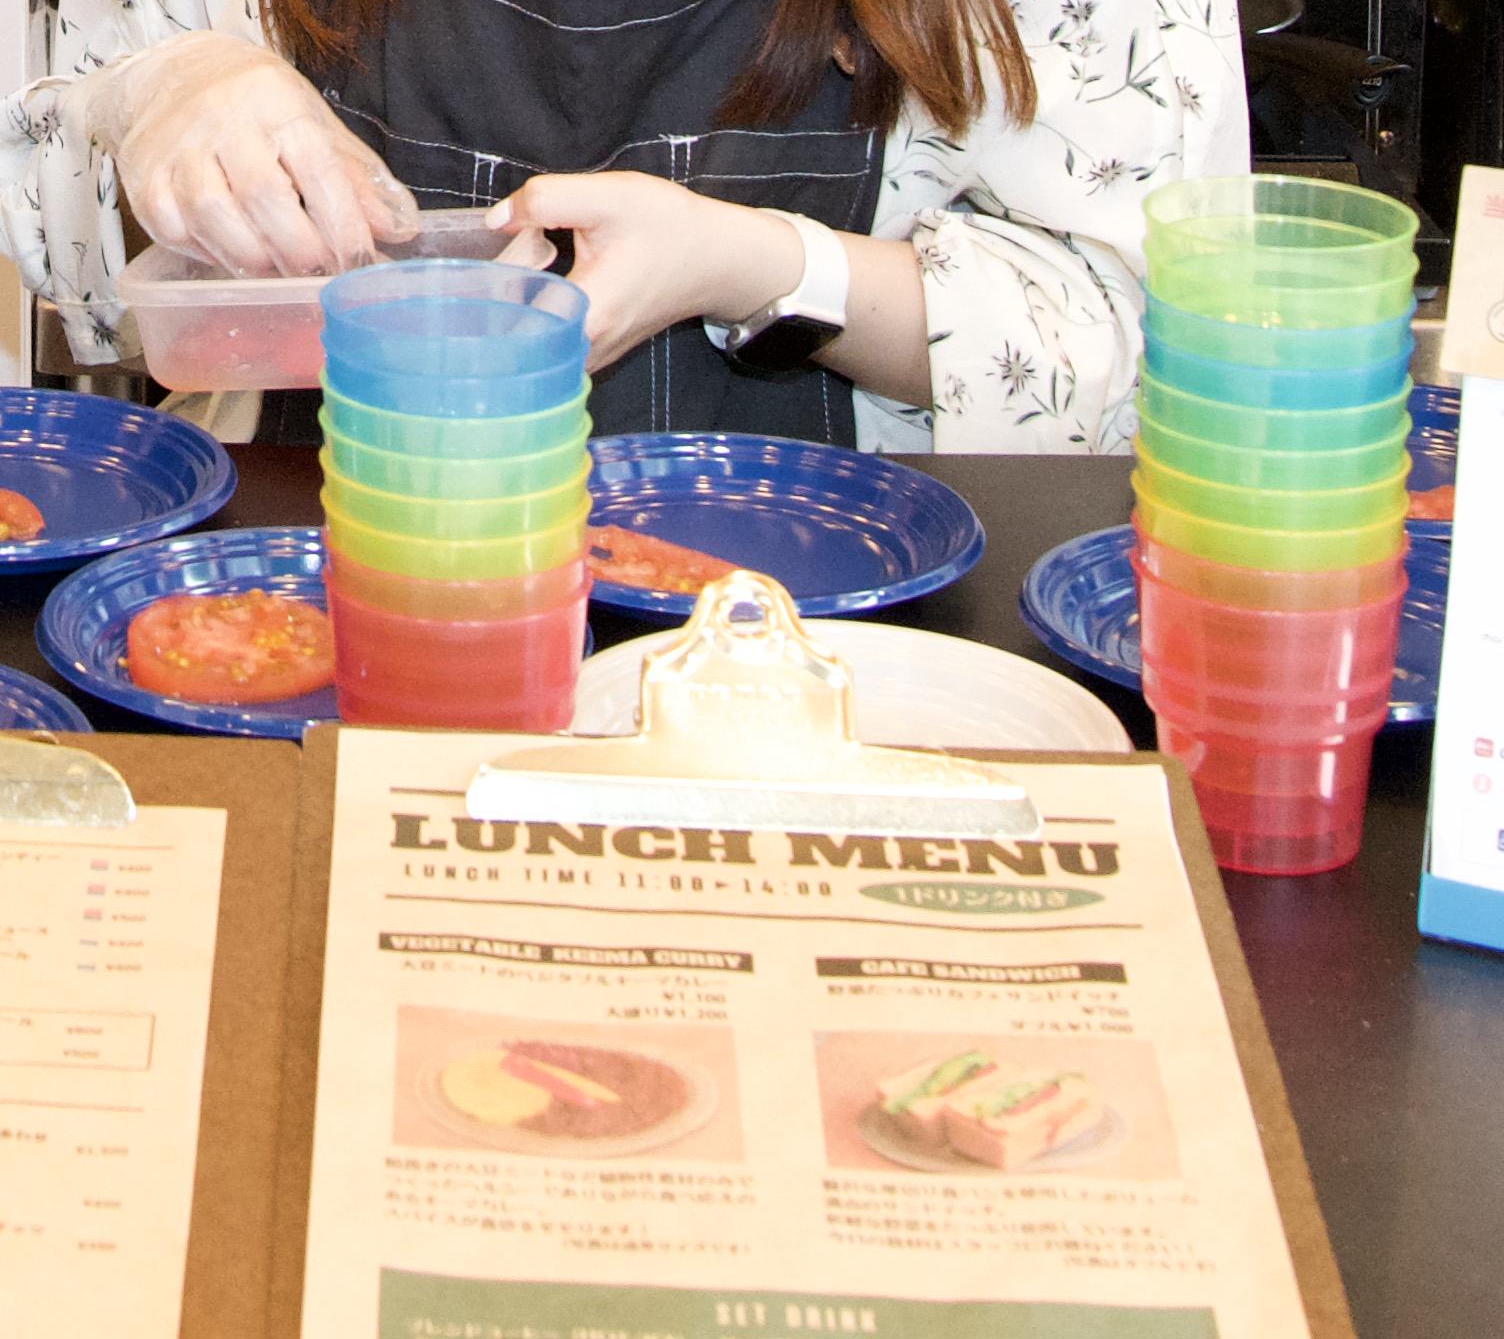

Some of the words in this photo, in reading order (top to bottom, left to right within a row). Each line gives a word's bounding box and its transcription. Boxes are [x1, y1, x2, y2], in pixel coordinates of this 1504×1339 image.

[390, 814, 756, 864] LUNCH
[787, 831, 1120, 878] MENU
[404, 864, 501, 882] LUNCH
[523, 868, 594, 887] TIME
[389, 933, 542, 962] VEGETABLE
[859, 959, 929, 976] CAFE
[931, 963, 1082, 983] SANDWICH
